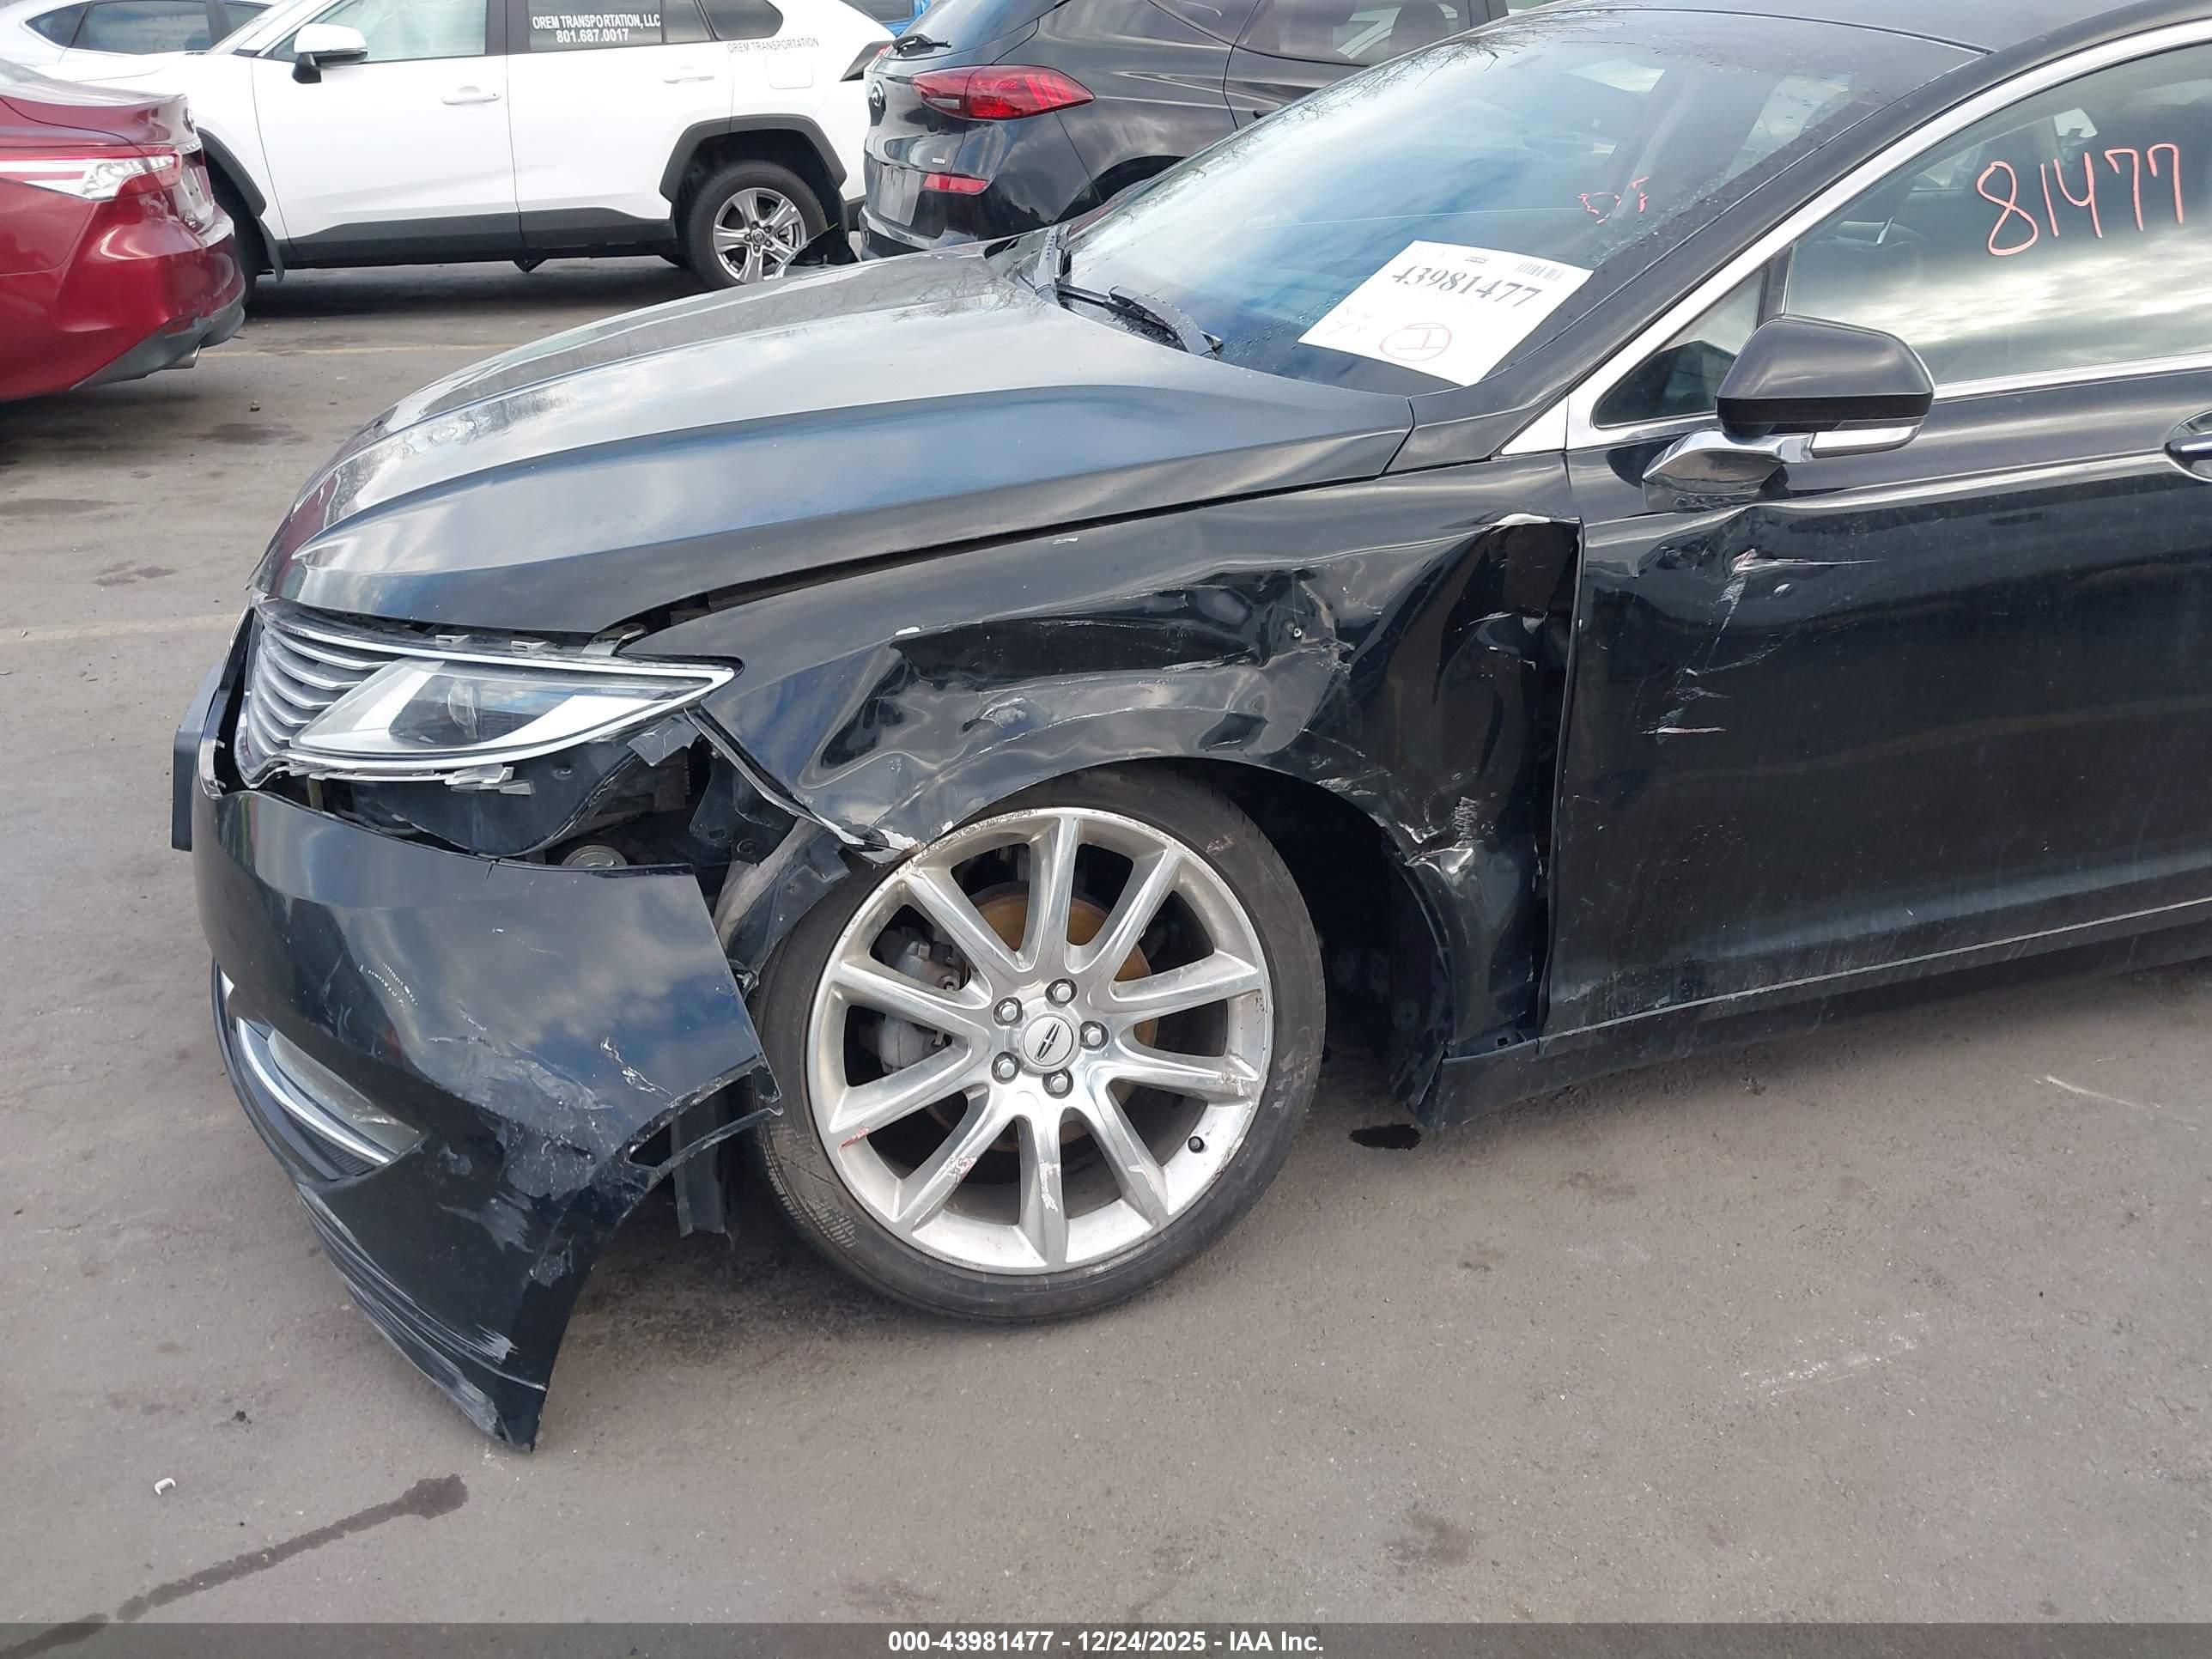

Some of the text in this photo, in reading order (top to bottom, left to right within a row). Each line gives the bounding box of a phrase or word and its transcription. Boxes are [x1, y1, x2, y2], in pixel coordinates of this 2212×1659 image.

[532, 14, 661, 29] OREM TRANSPORTATION, LLC
[556, 28, 629, 42] 801.687.0017
[727, 37, 819, 52] OREM TRANSPORTATION
[1977, 143, 2184, 256] 81477
[1392, 265, 1543, 307] 43981477
